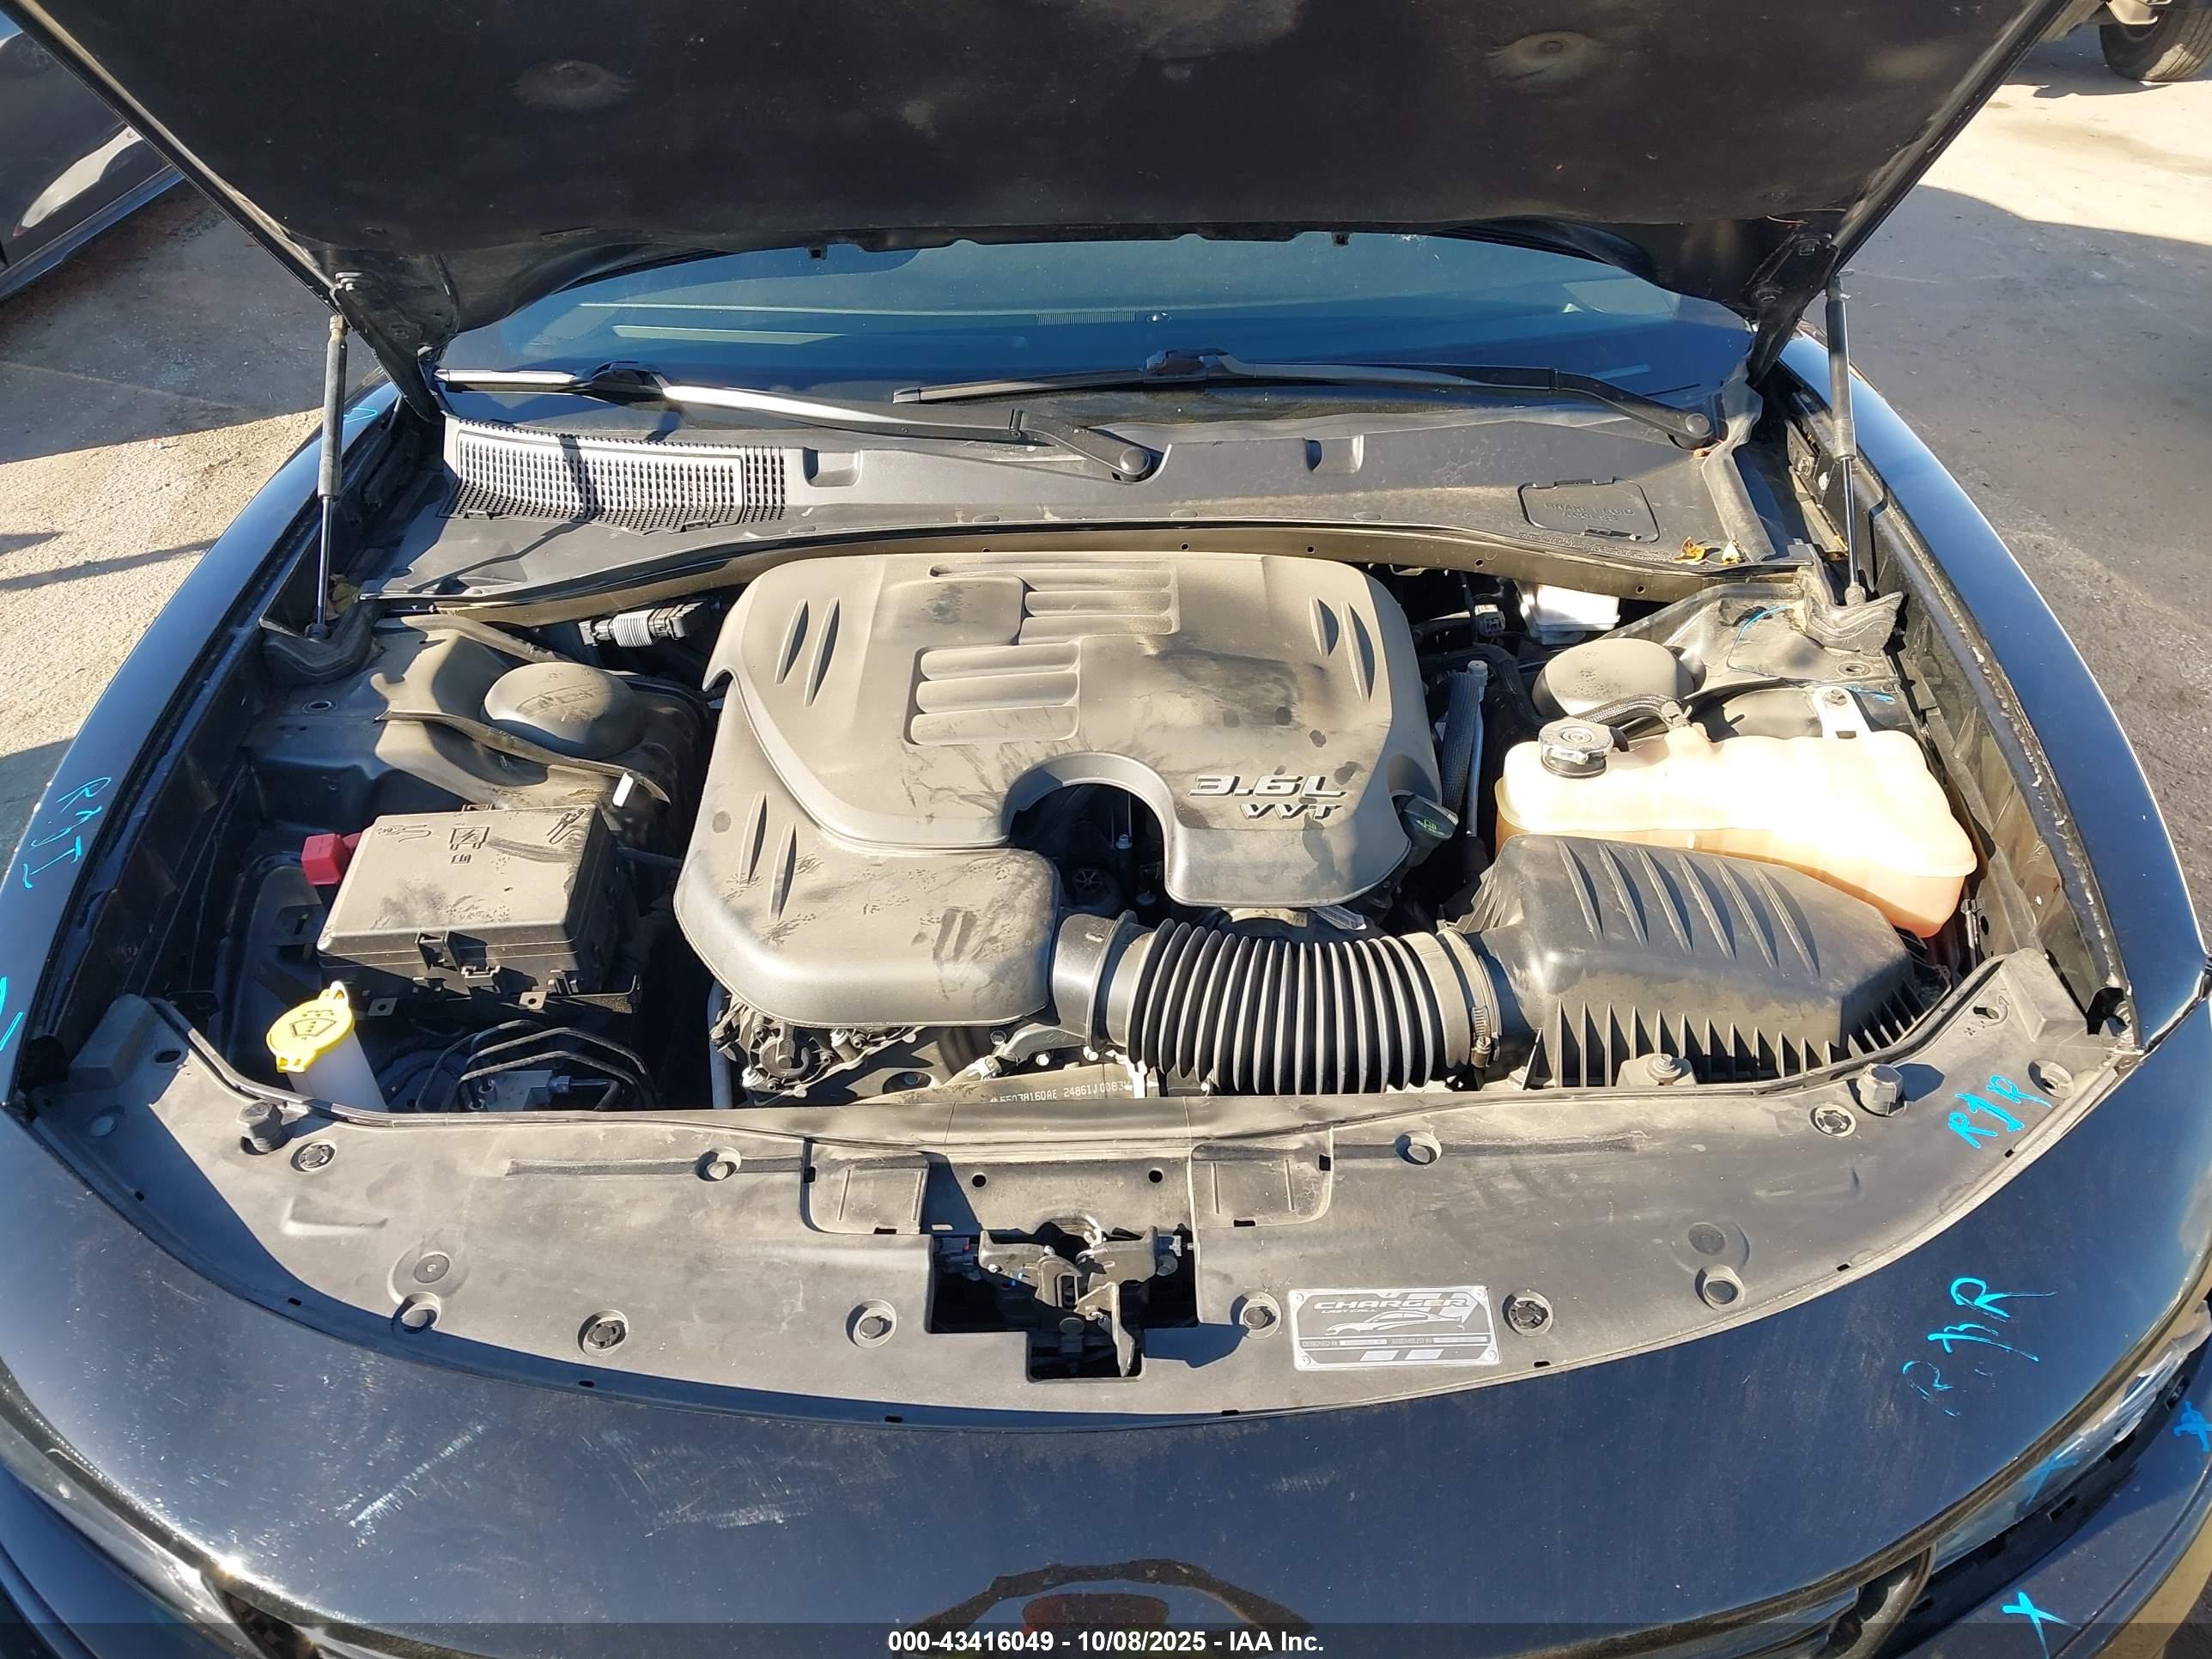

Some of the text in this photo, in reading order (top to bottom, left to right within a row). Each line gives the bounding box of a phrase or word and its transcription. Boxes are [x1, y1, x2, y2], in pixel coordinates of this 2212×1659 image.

[1188, 775, 1347, 797] 3.6L
[1240, 804, 1342, 819] VVT
[1314, 1299, 1470, 1310] CHARGER
